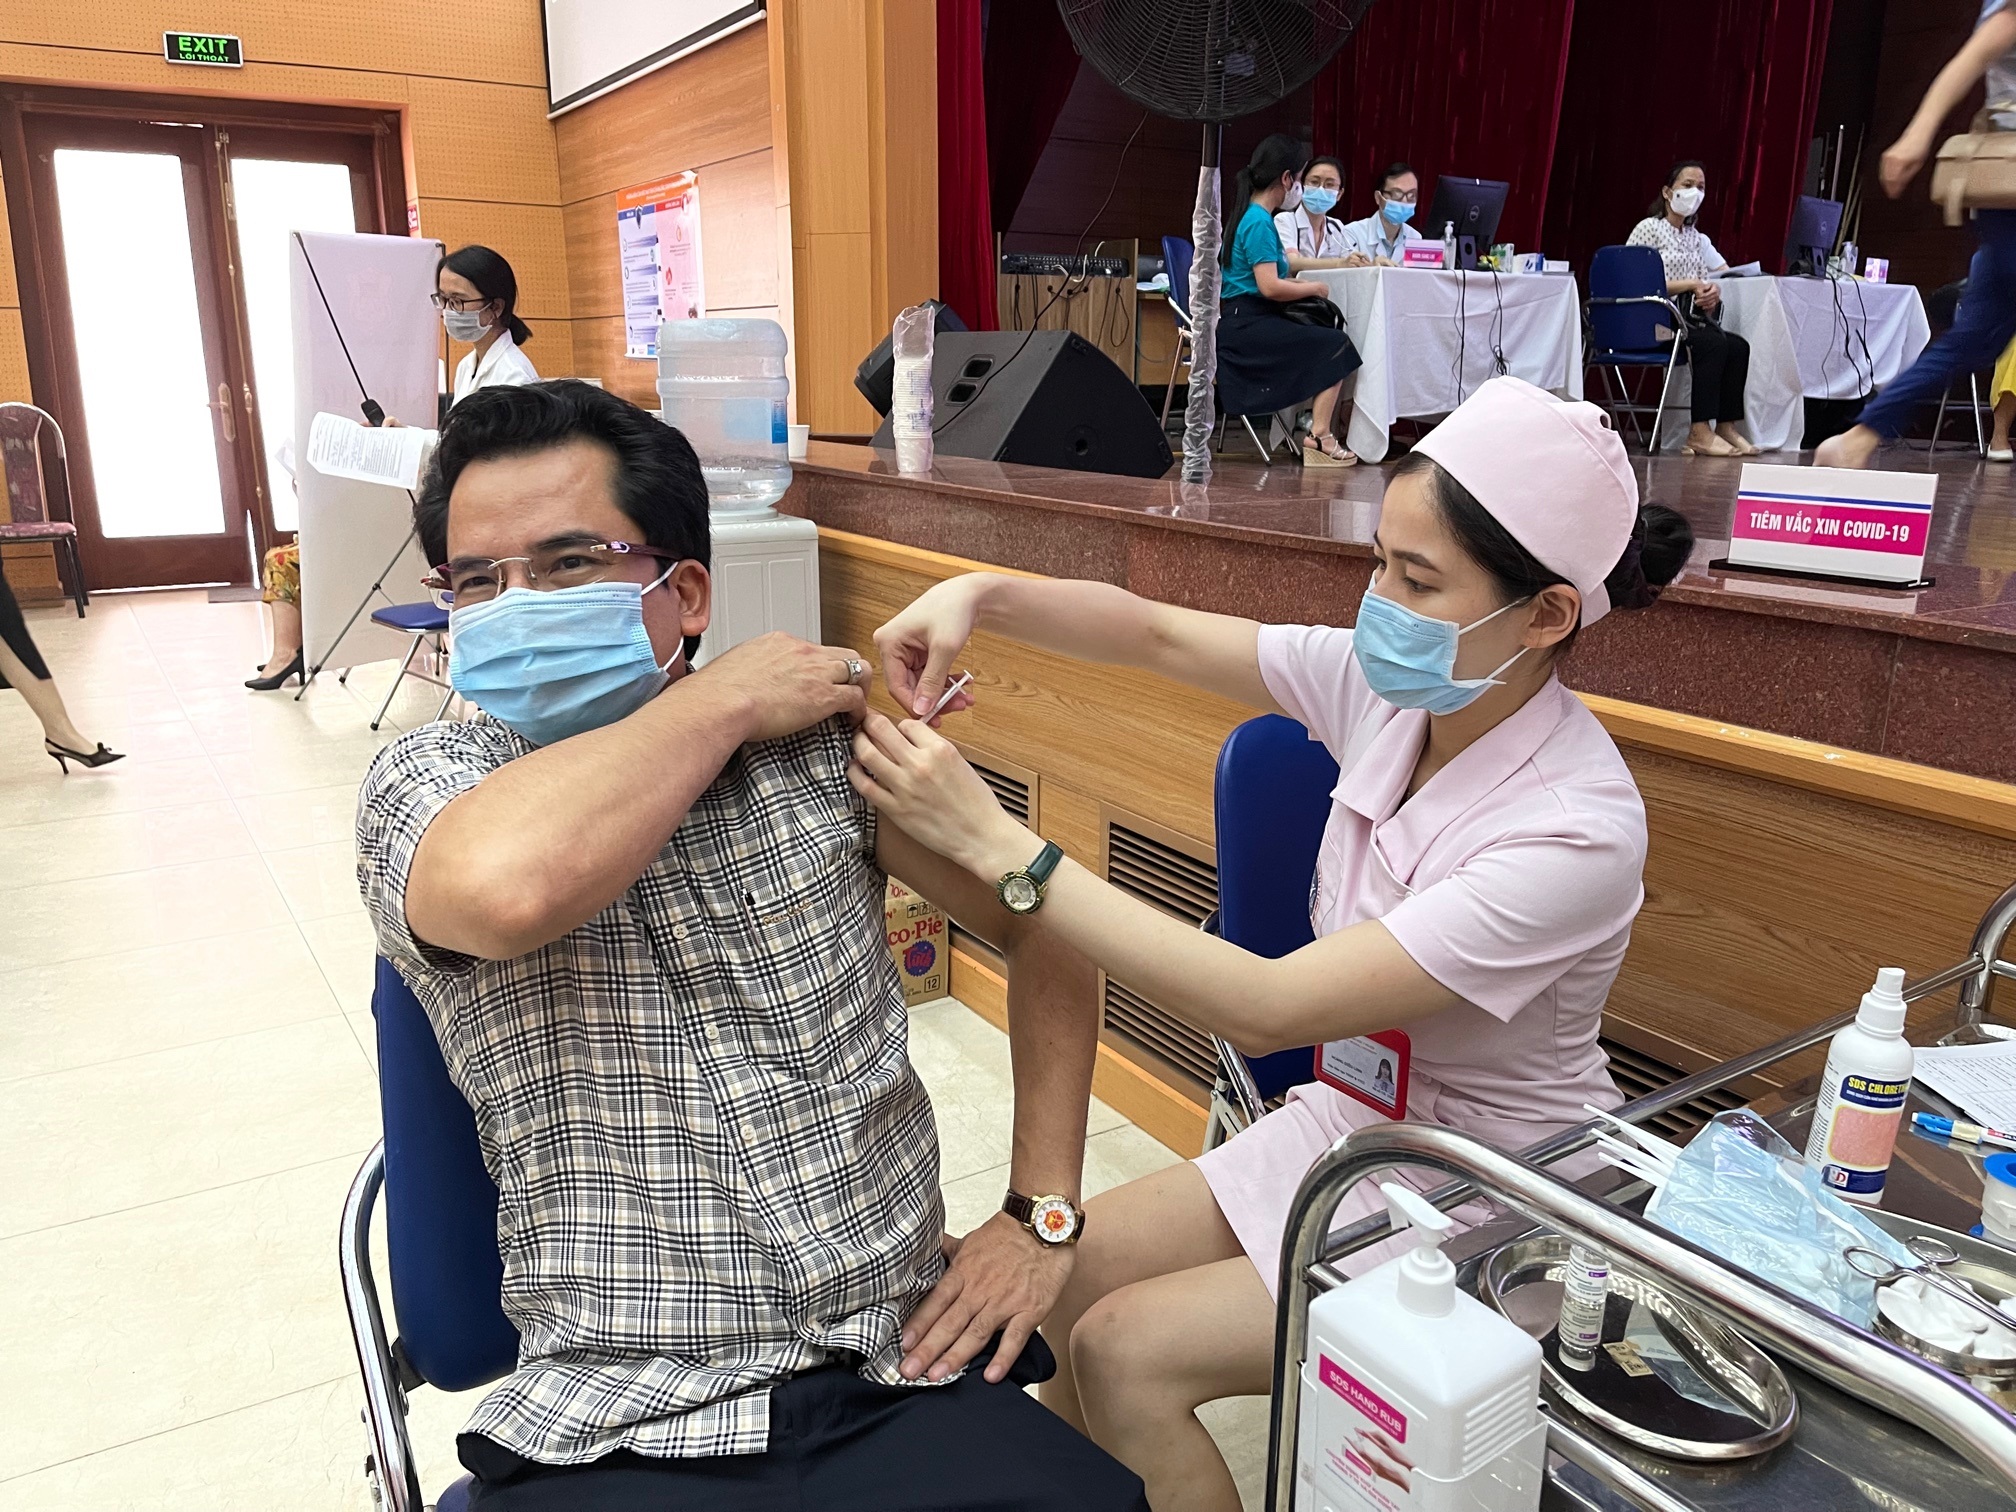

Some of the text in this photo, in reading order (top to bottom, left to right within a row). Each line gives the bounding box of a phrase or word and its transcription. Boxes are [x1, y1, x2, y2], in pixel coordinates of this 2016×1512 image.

[178, 36, 228, 54] EXIT
[1750, 510, 1910, 543] TIÊM VẮC XIN COVID-19
[926, 978, 938, 990] 12
[1848, 1077, 1867, 1091] SDS
[1329, 1370, 1350, 1391] SDS
[1350, 1388, 1379, 1414] HAND
[1379, 1410, 1402, 1432] RUB
